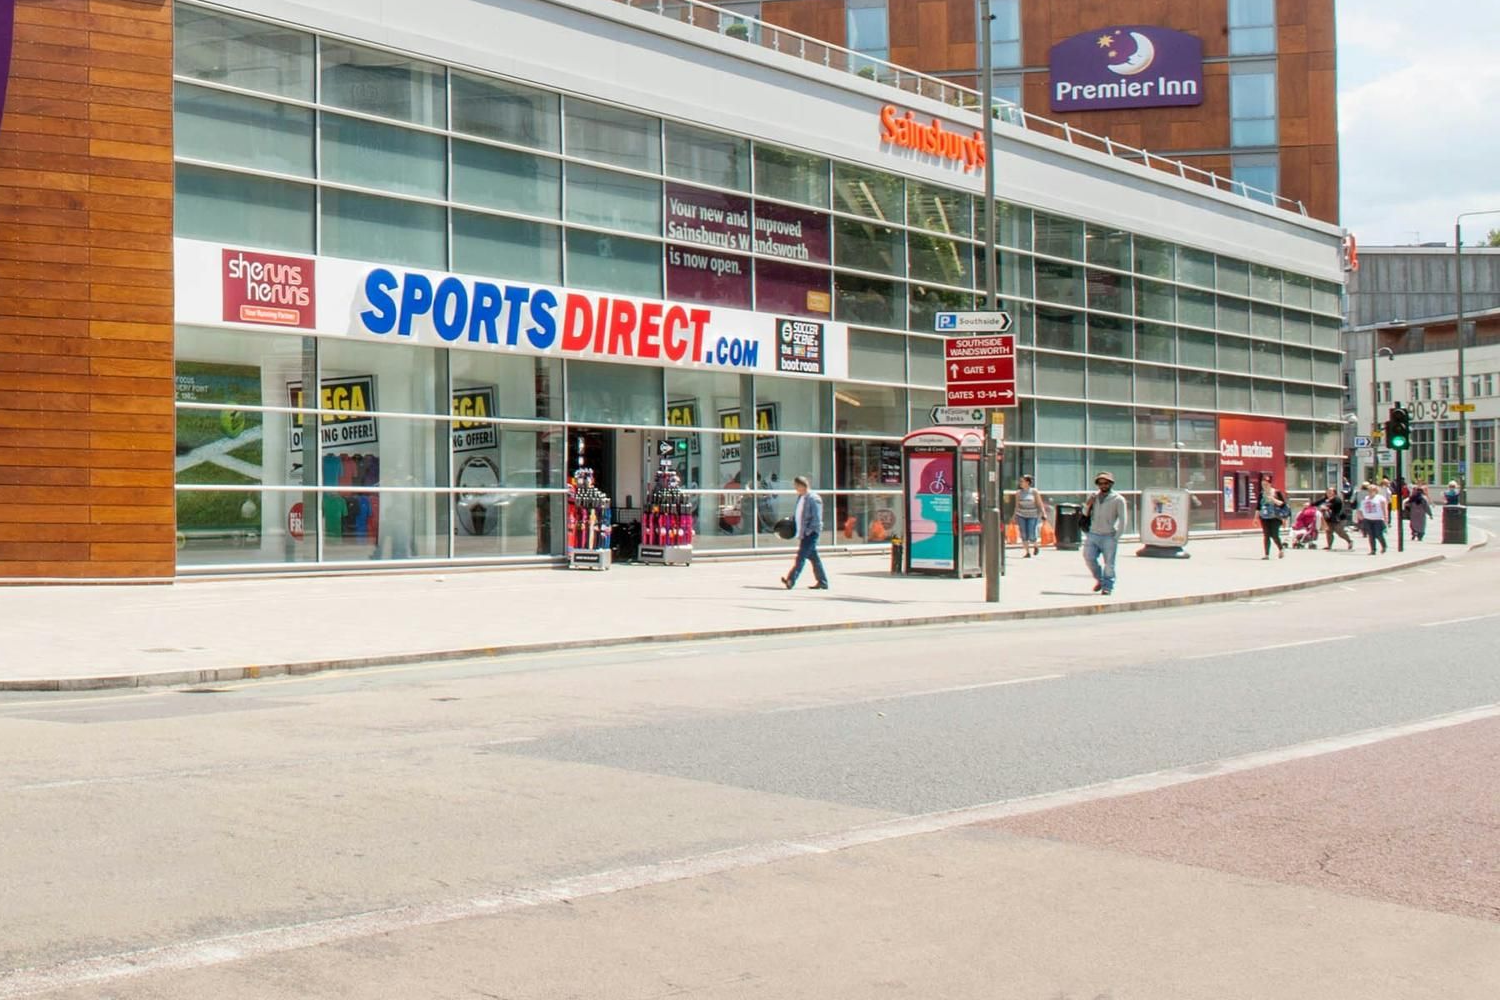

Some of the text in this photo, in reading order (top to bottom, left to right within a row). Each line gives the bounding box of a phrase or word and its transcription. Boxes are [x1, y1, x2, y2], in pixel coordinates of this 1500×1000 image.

[1056, 77, 1197, 101] Premier Inn
[880, 104, 985, 175] Sainsbury's
[669, 197, 698, 219] Your
[700, 206, 724, 224] new
[726, 210, 749, 228] and
[668, 221, 737, 248] Sainsbury's
[669, 246, 742, 277] is now open.
[949, 346, 1010, 357] WANDSWORTH
[956, 338, 1003, 348] SOUTHSIDE
[963, 365, 997, 375] GATE 15
[948, 391, 974, 400] GATES
[341, 423, 374, 442] OFFER!
[465, 431, 494, 445] OFFER!
[721, 447, 740, 460] OPEN
[1220, 439, 1273, 459] Cash machines
